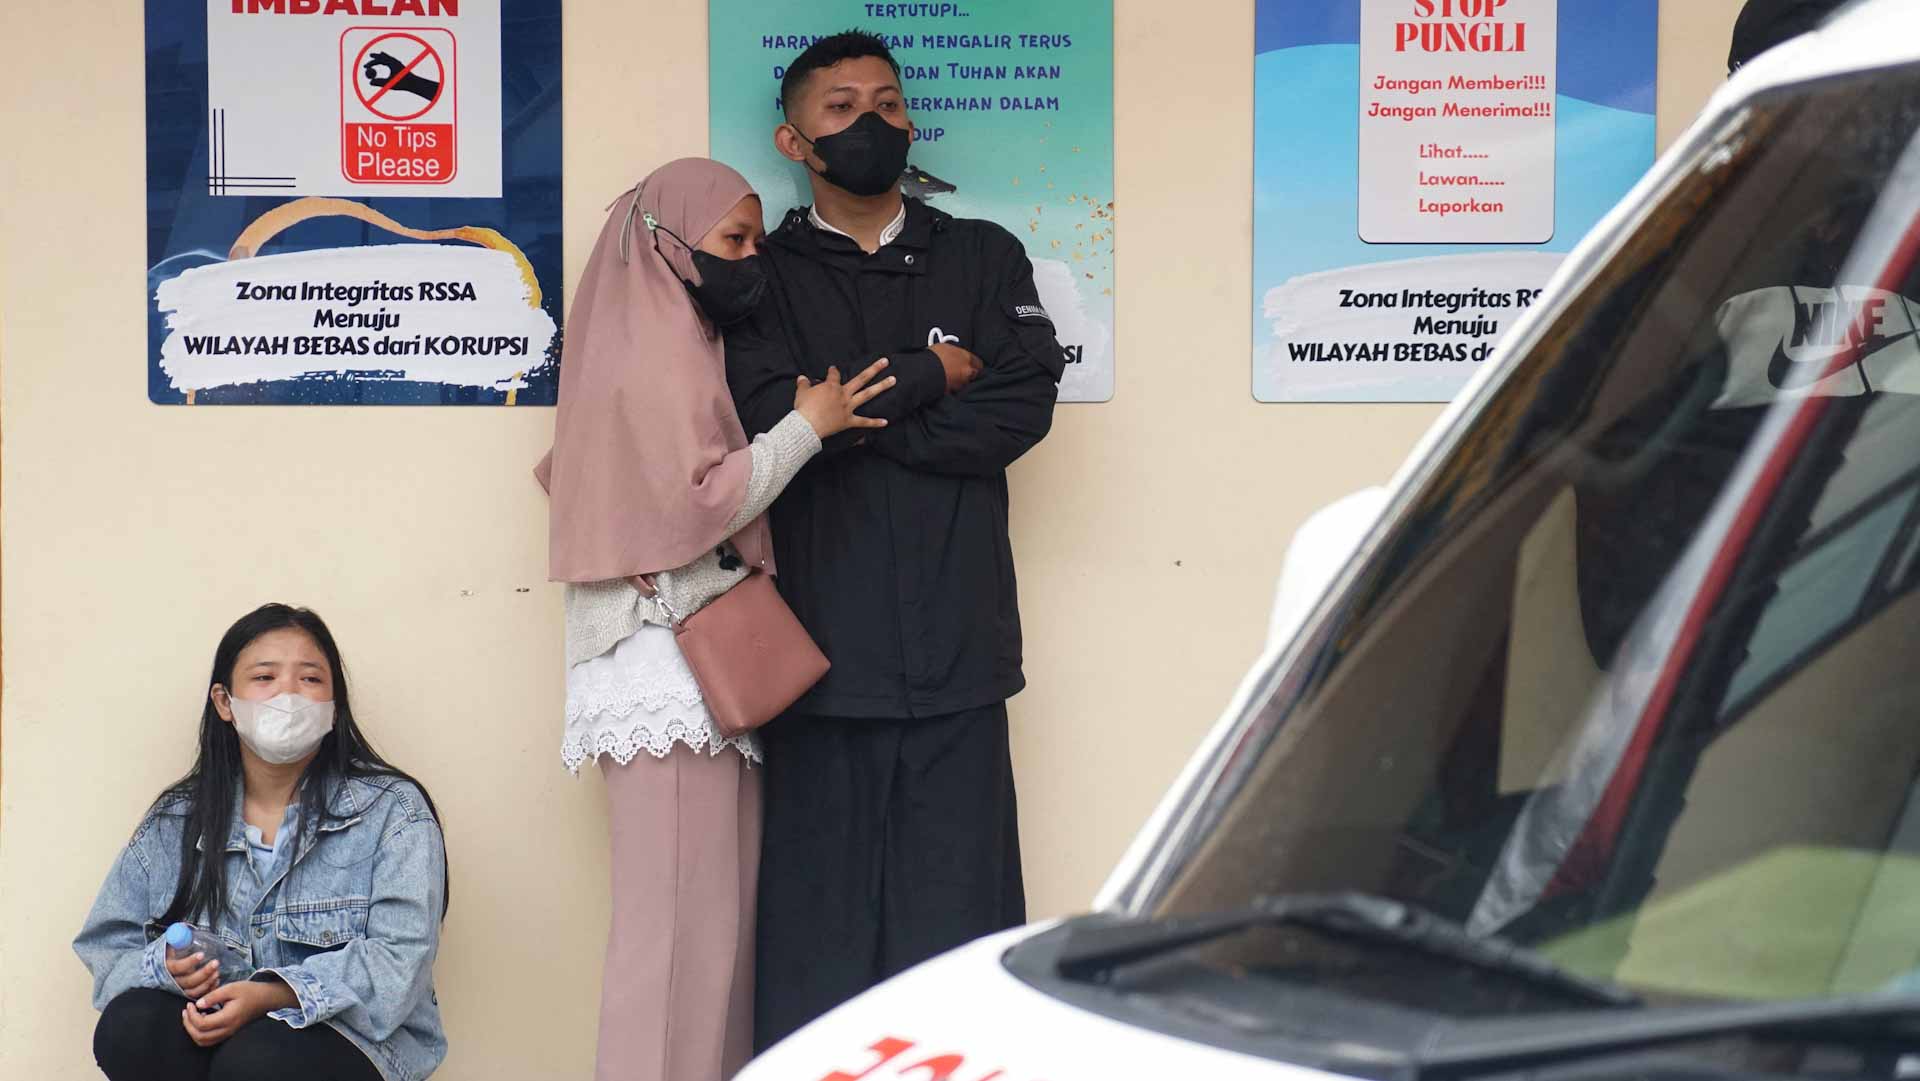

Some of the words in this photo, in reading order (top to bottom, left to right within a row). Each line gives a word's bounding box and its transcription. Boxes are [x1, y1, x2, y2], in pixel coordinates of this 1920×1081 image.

[865, 3, 970, 18] TERTUTUPI...
[1414, 0, 1508, 18] STOP
[922, 34, 1012, 50] MENGALIR
[1019, 34, 1072, 49] TERUS
[1395, 23, 1526, 52] PUNGLI
[904, 65, 939, 80] DAN
[1014, 65, 1060, 80] AKAN
[1374, 76, 1442, 94] Jangan
[1448, 75, 1546, 90] Memberi!!!
[1000, 96, 1059, 111] DALAM
[1368, 103, 1436, 121] Jangan
[1442, 102, 1551, 117] Menerima!!!
[357, 126, 387, 148] No
[393, 126, 437, 152] Tips
[357, 152, 440, 177] Please
[1419, 197, 1504, 217] Laporkan
[236, 281, 296, 301] Zona
[301, 281, 413, 306] Integritas
[418, 282, 477, 301] RSSA
[1339, 289, 1398, 308] Zona
[1402, 287, 1511, 313] Integritas
[313, 308, 400, 330] Menuju
[1413, 314, 1498, 338] Menuju
[183, 336, 288, 356] WILAYAH
[293, 336, 369, 356] BEBAS
[373, 335, 420, 356] dari
[425, 335, 528, 356] KORUPSI
[1288, 342, 1389, 362] WILAYAH
[1393, 342, 1467, 362] BEBAS
